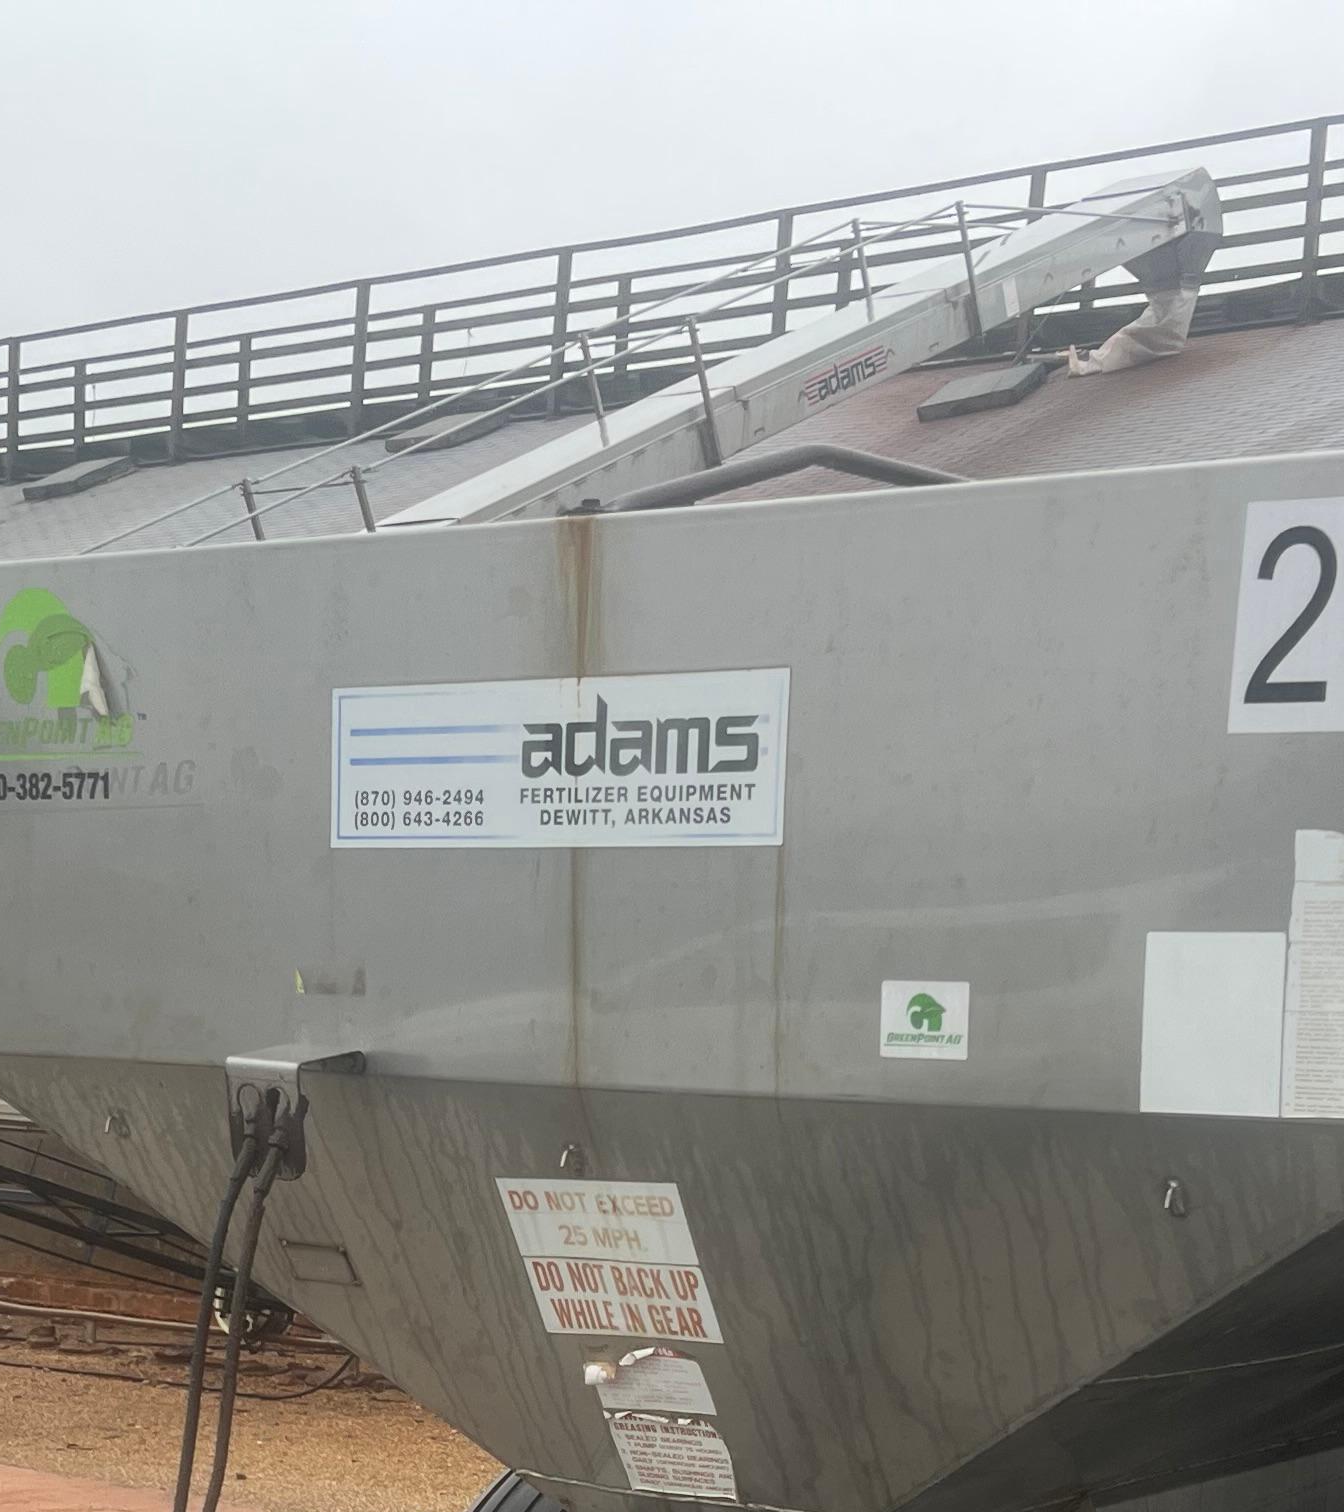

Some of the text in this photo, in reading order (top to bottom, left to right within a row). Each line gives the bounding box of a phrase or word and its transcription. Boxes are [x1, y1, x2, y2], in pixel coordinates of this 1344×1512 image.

[818, 356, 877, 401] adams
[520, 693, 760, 778] adams
[353, 787, 485, 808] (870) 946-2494
[519, 783, 757, 805] FERTILIZER EQUIPMENT
[353, 809, 485, 829] (800) 643-4266
[538, 805, 733, 828] DEWITT, ARKANSAS
[507, 1189, 675, 1217] DO NOT EXCEED
[558, 1224, 588, 1246] 25
[532, 1260, 699, 1302] DO NOT BACK UP
[550, 1298, 708, 1338] WHILE IN GEAR
